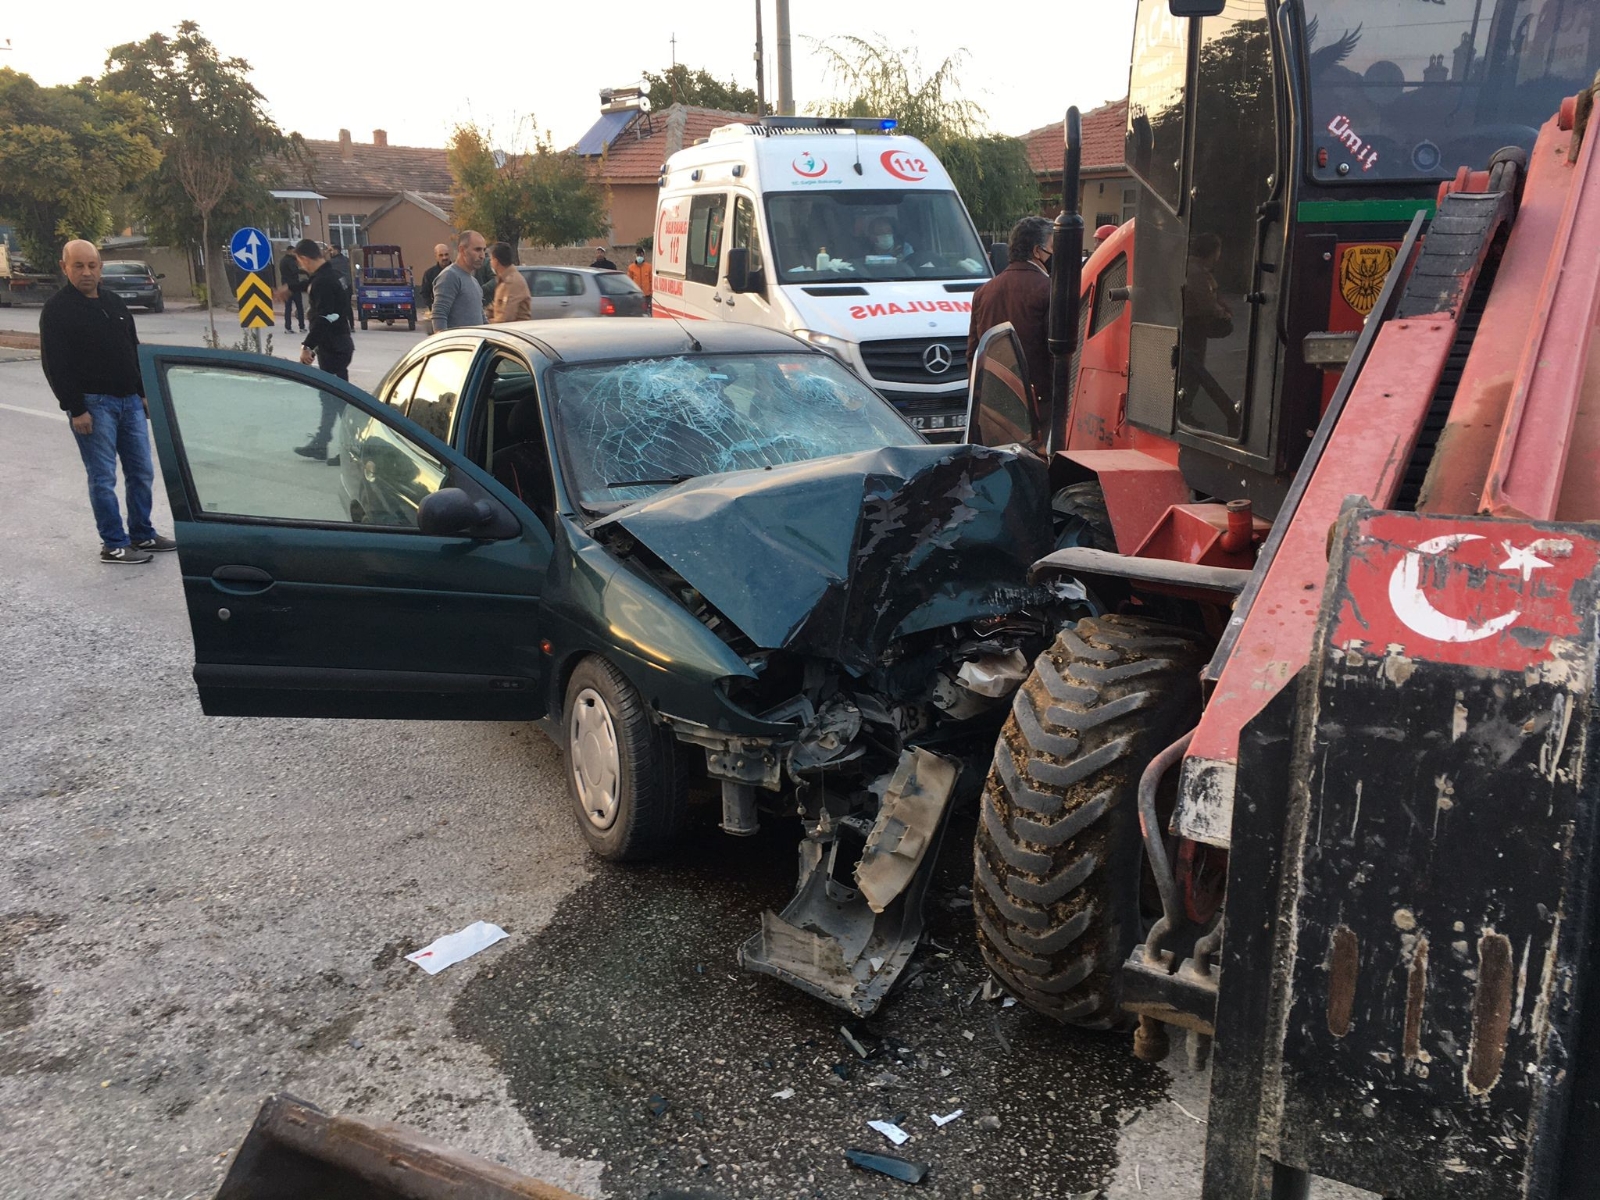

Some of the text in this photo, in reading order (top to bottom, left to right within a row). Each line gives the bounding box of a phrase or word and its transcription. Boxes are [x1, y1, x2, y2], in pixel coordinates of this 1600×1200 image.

[1328, 115, 1378, 171] Ümit
[894, 158, 929, 173] 112
[669, 236, 680, 264] 112
